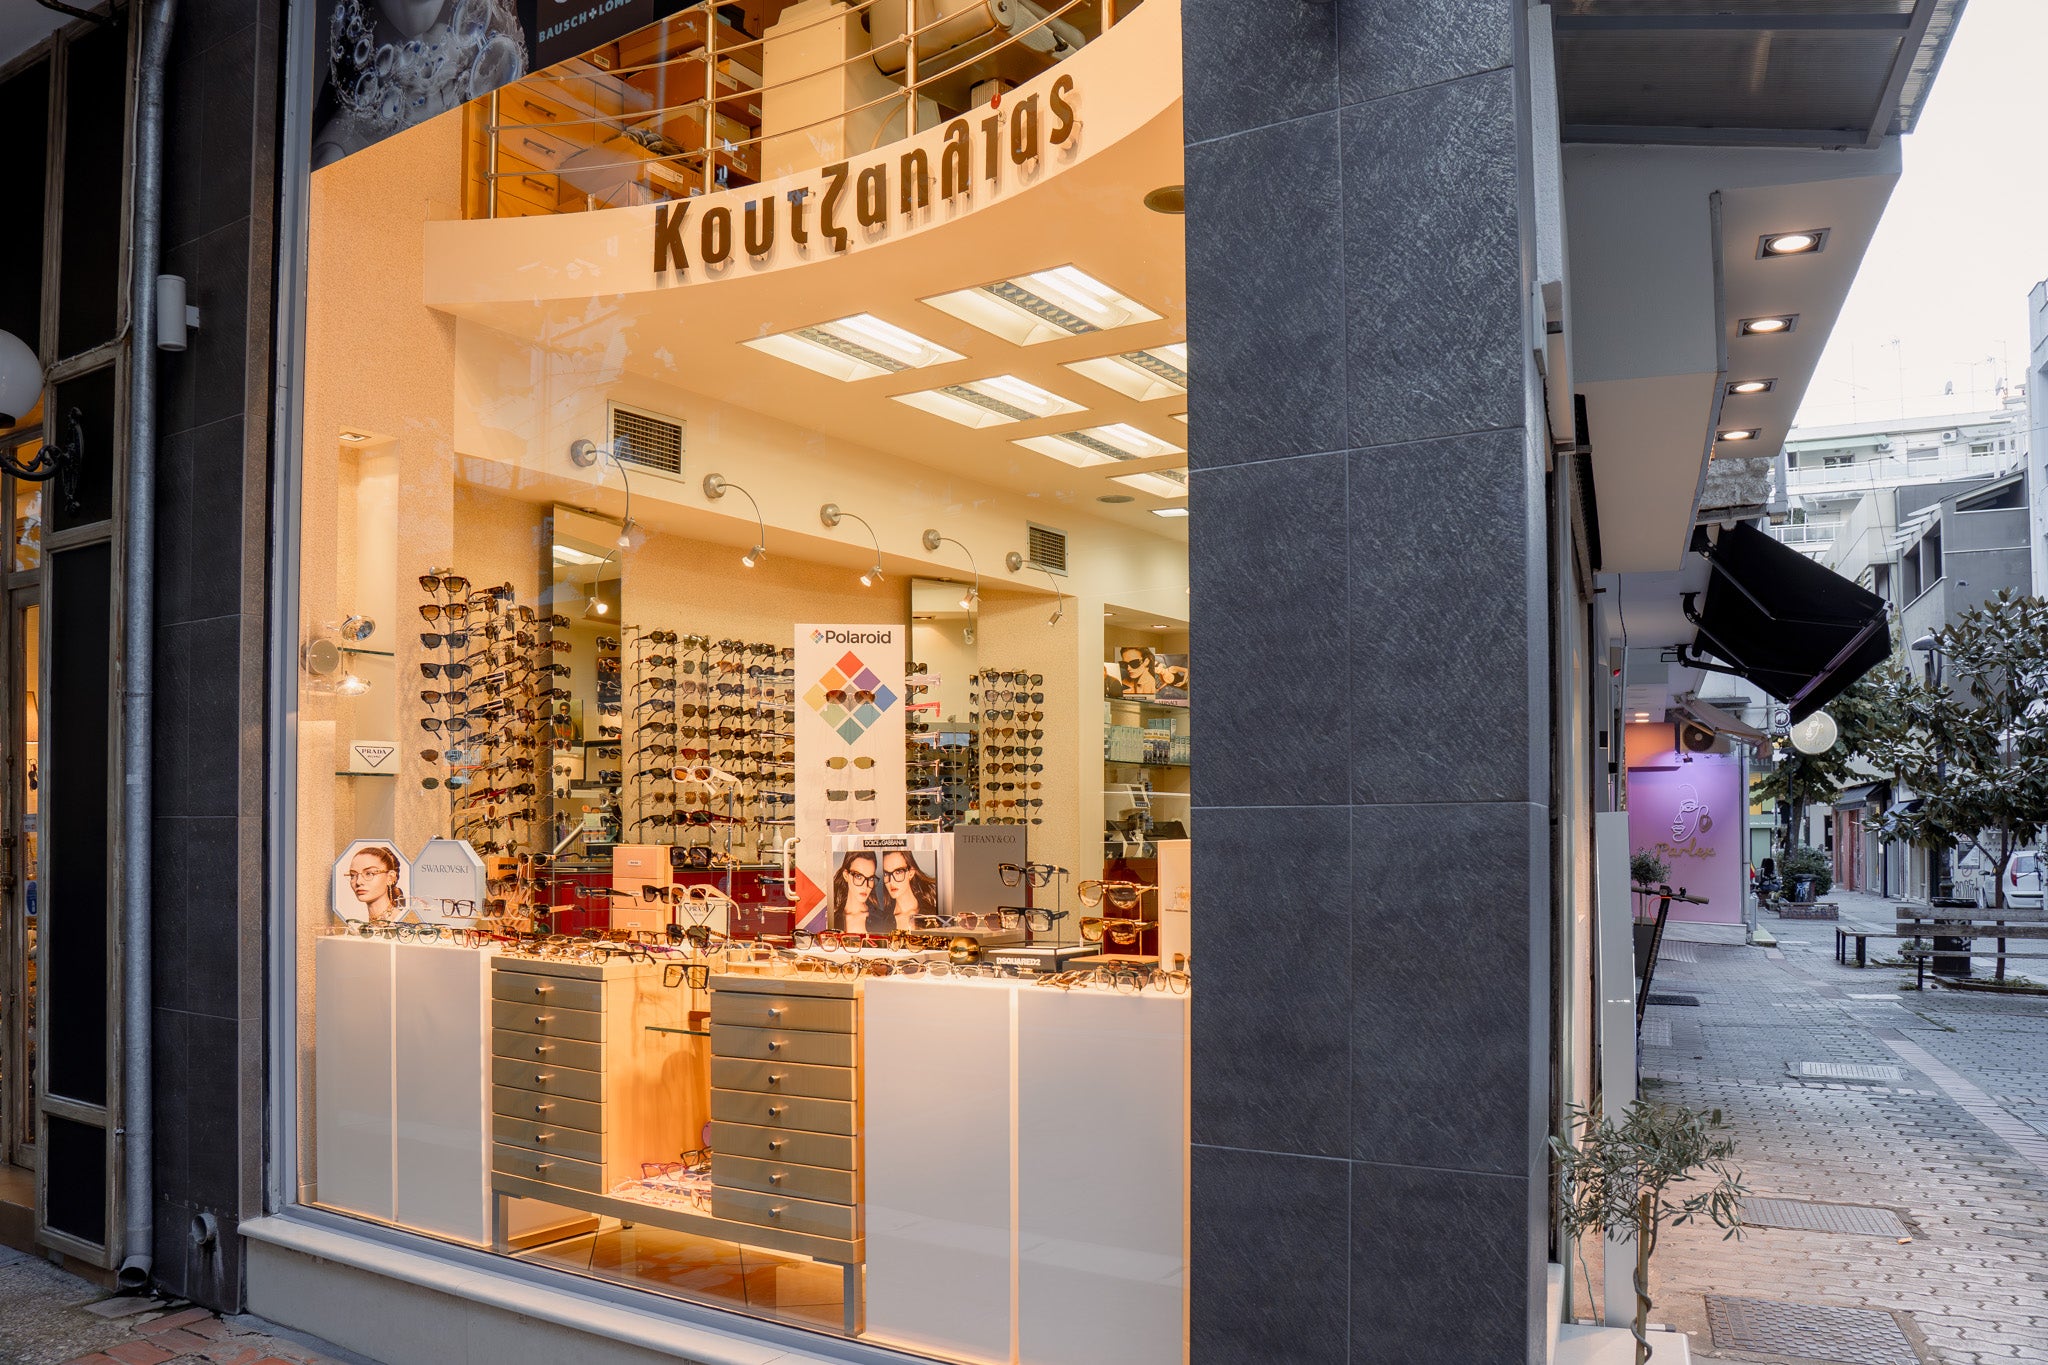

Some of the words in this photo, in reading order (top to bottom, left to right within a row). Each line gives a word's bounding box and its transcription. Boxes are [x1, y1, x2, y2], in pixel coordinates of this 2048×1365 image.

[825, 630, 892, 644] Polaroid
[421, 864, 469, 874] SWAROVSKI
[996, 957, 1041, 966] DSQUARED2
